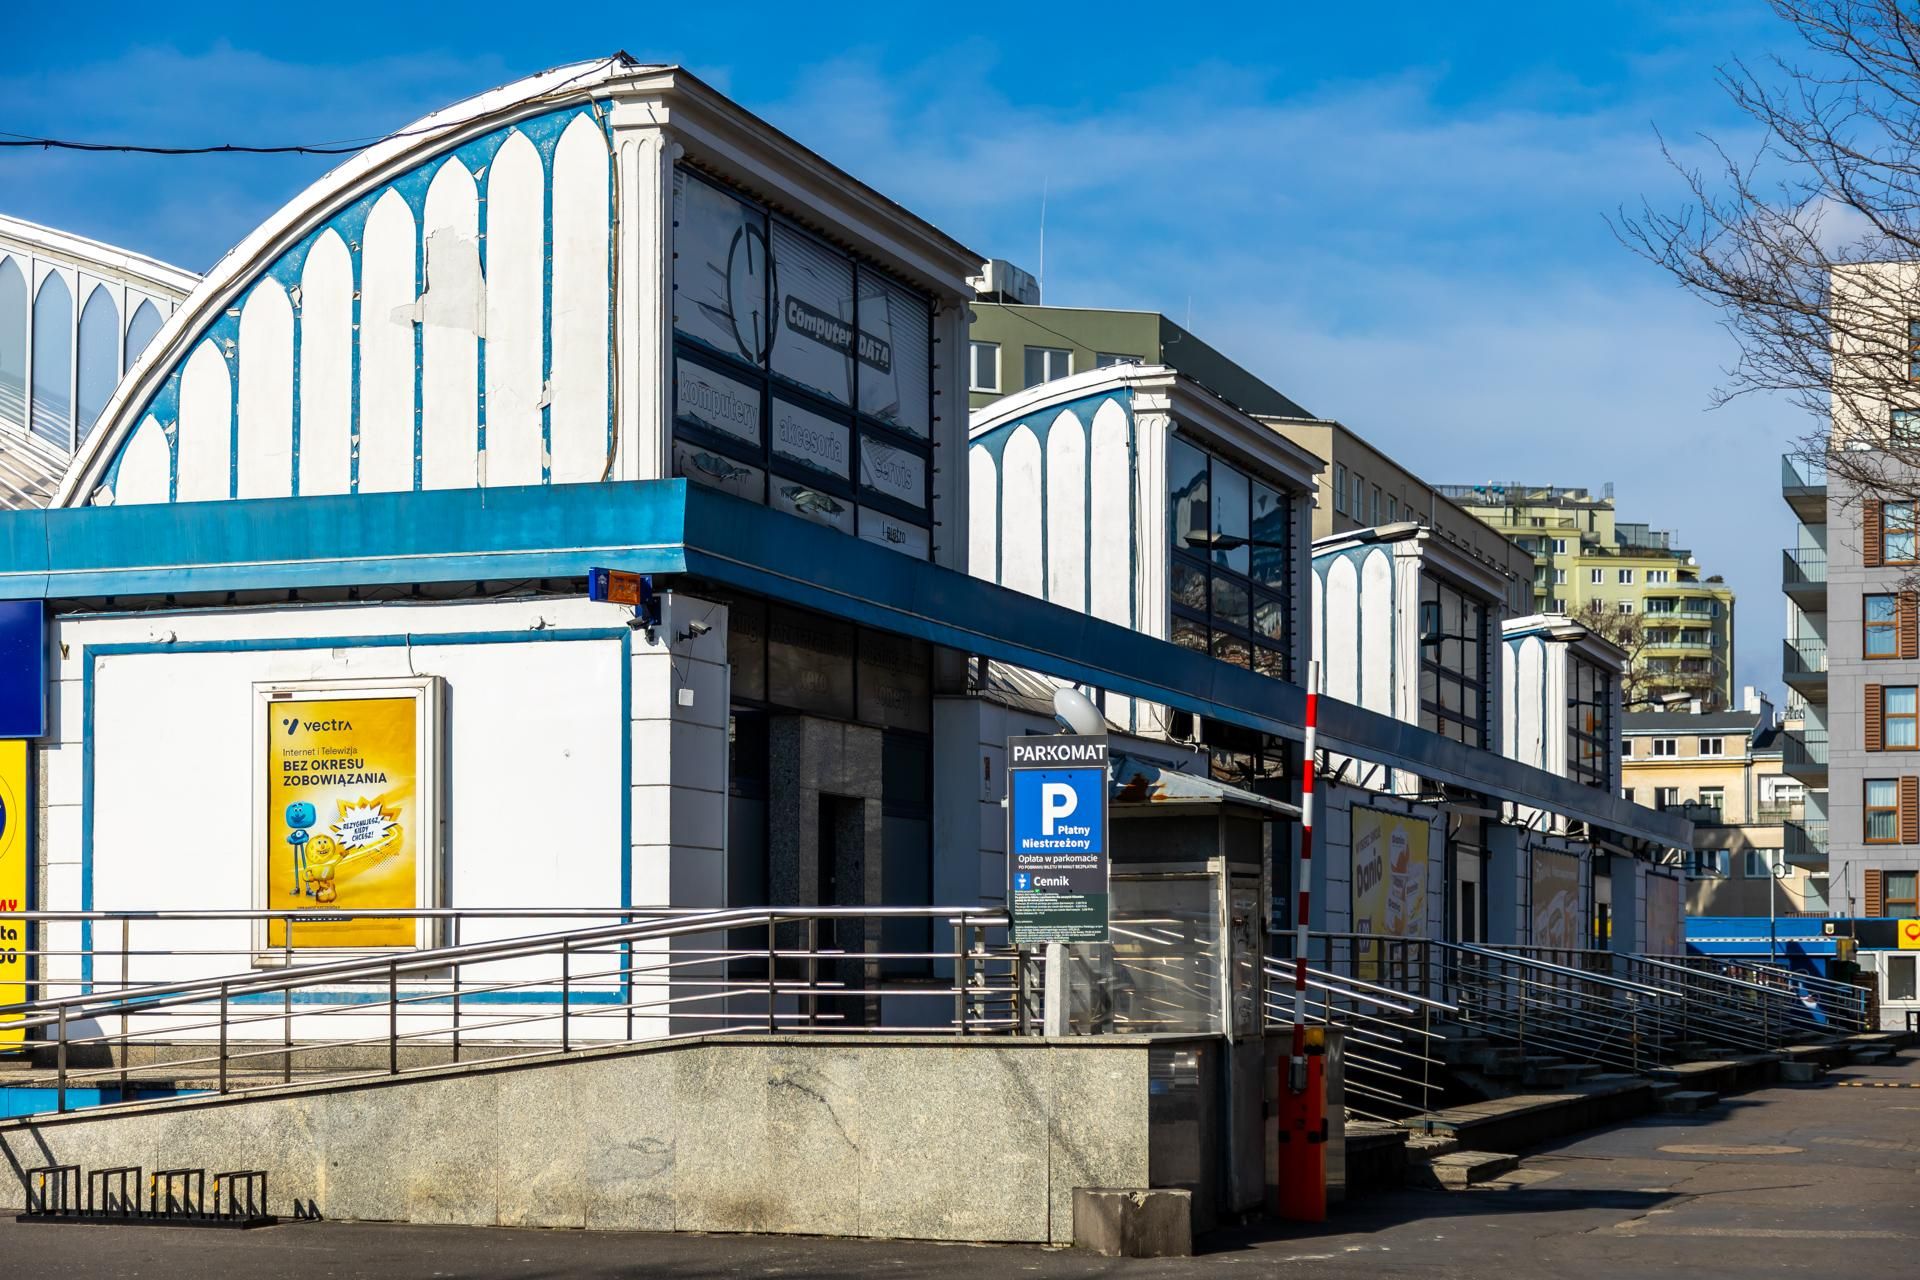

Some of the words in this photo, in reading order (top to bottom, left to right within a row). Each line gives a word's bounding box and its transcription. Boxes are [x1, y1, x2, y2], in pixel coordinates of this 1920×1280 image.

[788, 301, 852, 347] Computer
[859, 334, 889, 367] DATA
[680, 371, 758, 434] komputery
[779, 415, 843, 463] akcesoria
[875, 458, 912, 490] serwis
[283, 748, 315, 757] Internet
[322, 746, 358, 756] Telewizja
[1013, 744, 1107, 762] PARKOMAT
[283, 760, 308, 771] BEZ
[311, 758, 364, 771] OKRESU
[283, 772, 387, 787] ZOBOWIĄZANIA
[1042, 782, 1078, 836] P
[343, 816, 380, 830] REZYGNUJESZ,
[354, 826, 369, 834] KIEDY
[352, 831, 374, 841] CHCESZ!
[1057, 825, 1091, 836] Płatny
[1022, 837, 1090, 849] Niestrzeżony
[1018, 854, 1043, 864] Opłata
[1053, 853, 1098, 864] parkomacie
[1356, 847, 1383, 899] Danio
[1033, 875, 1070, 887] Cennik
